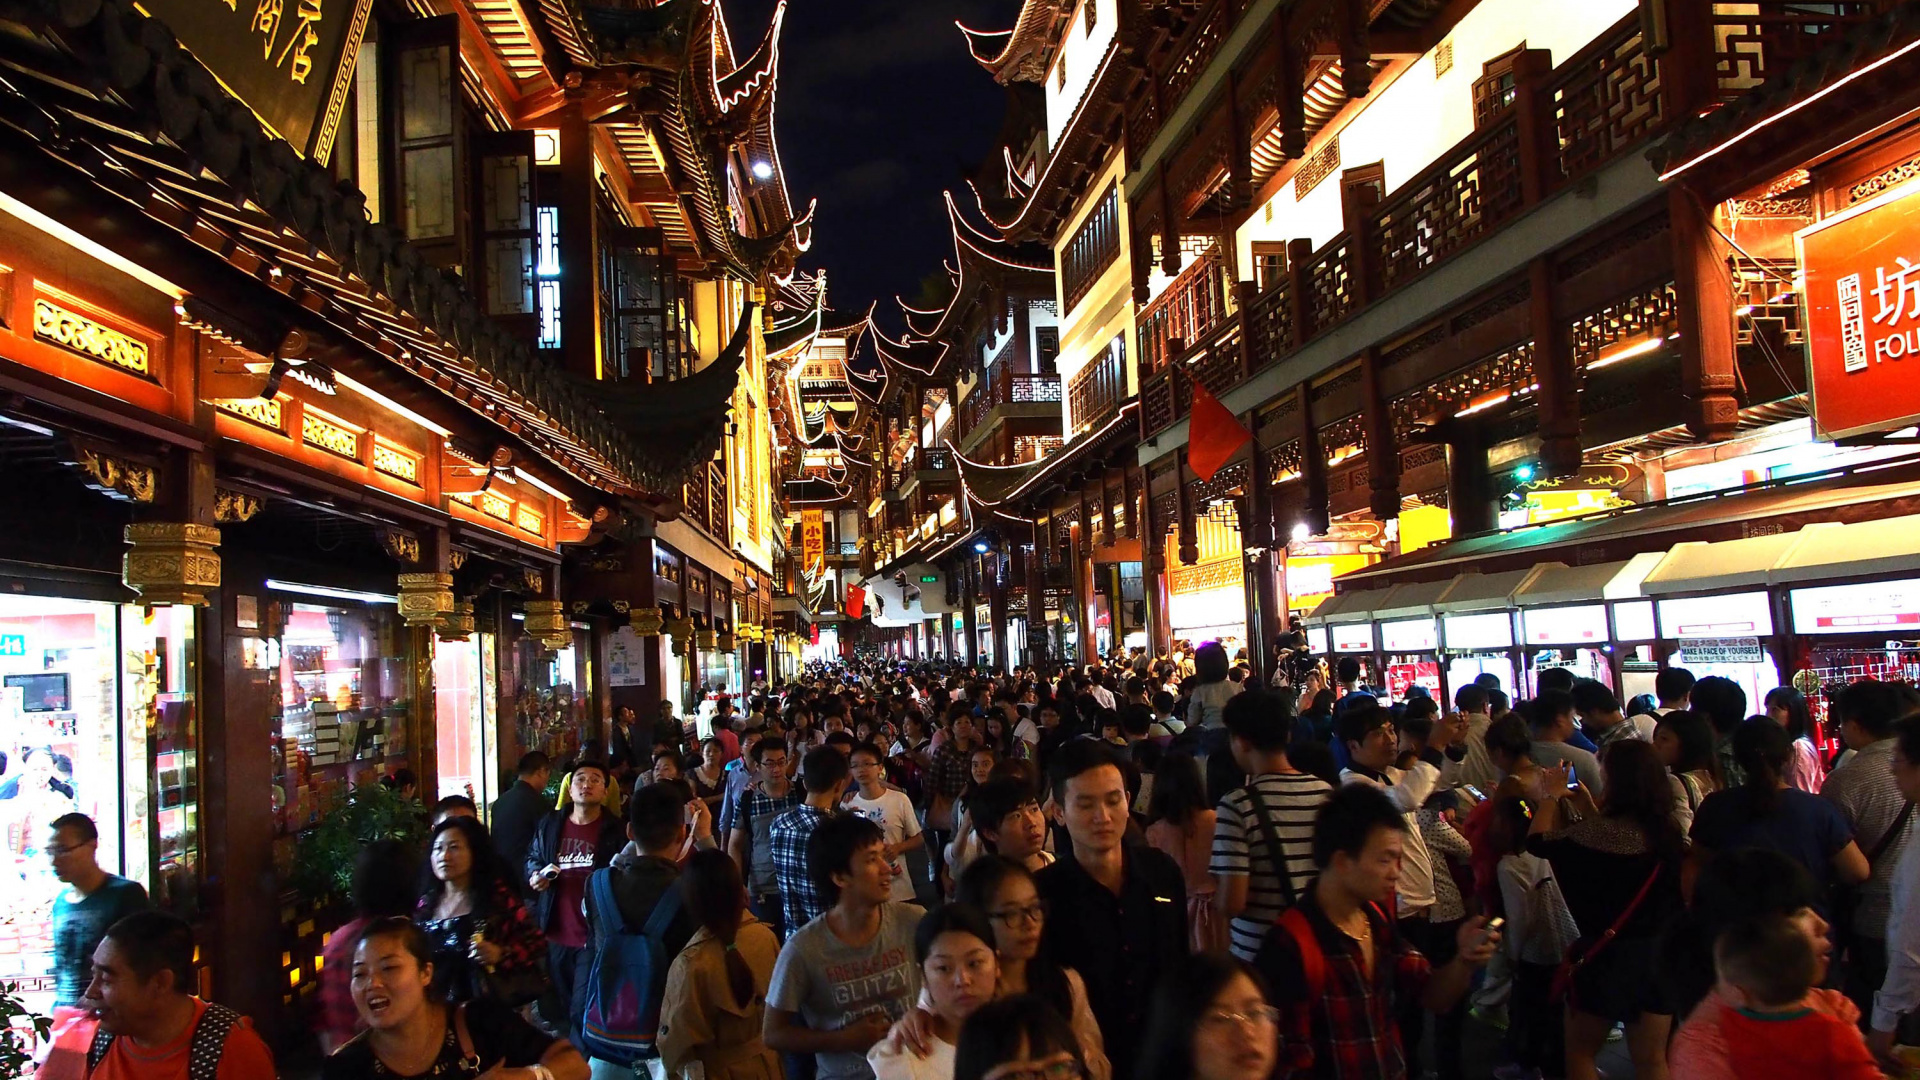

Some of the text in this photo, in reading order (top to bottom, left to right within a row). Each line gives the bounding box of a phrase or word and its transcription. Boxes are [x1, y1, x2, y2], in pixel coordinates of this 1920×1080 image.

[1874, 327, 1920, 363] FOL
[1704, 647, 1717, 655] FACE
[1719, 647, 1727, 655] OF
[1728, 646, 1758, 655] YOURSELF
[834, 969, 910, 1004] GLITZY
